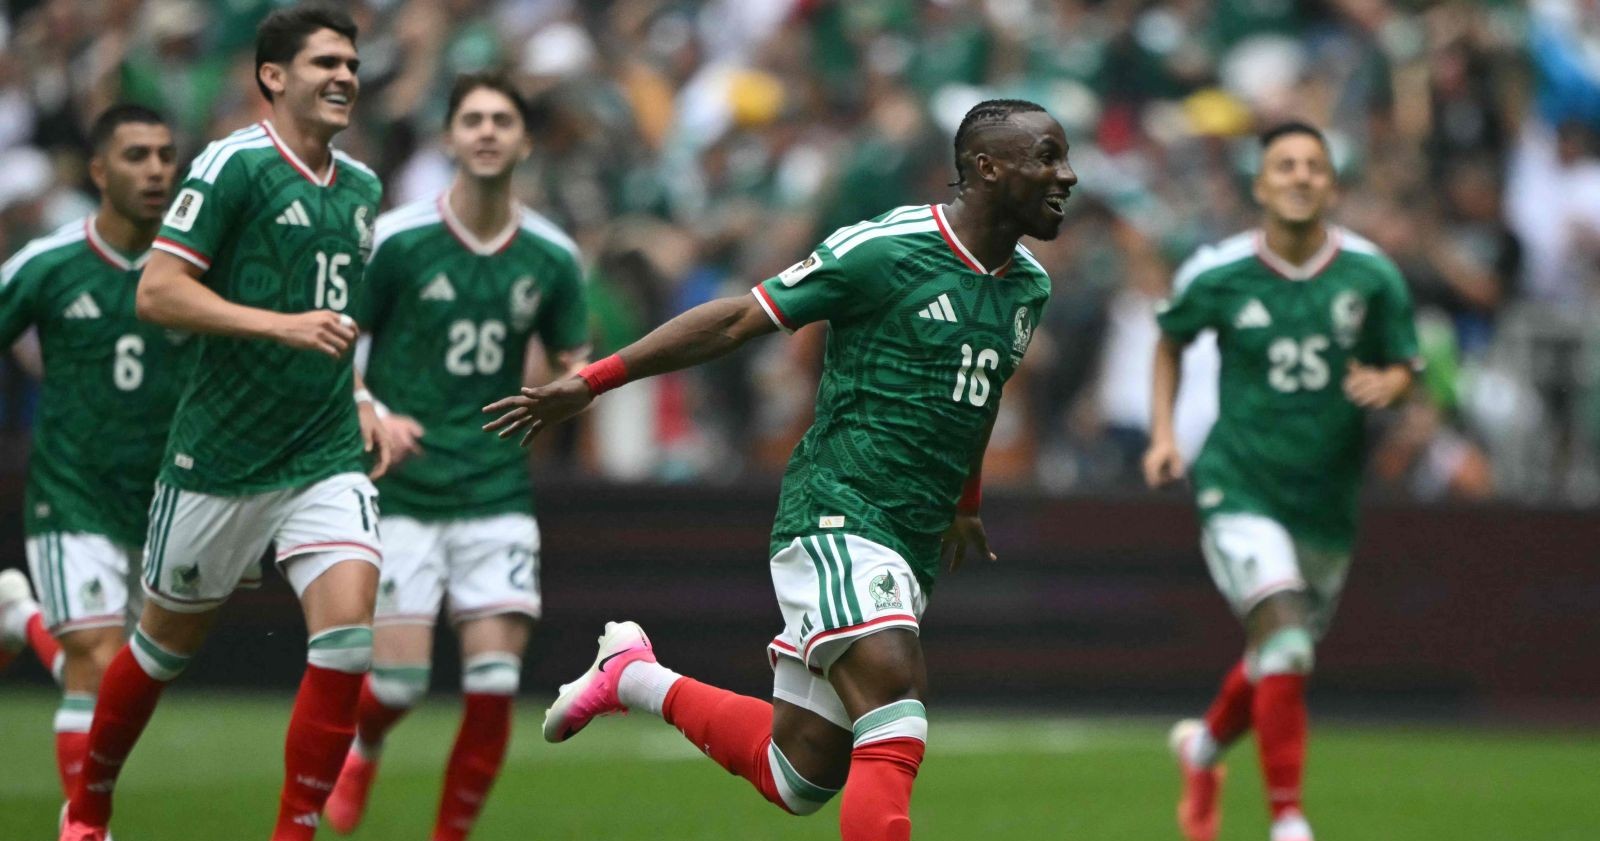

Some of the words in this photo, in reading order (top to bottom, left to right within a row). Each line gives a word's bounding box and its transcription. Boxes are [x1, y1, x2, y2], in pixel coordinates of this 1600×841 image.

[315, 251, 351, 311] 15
[114, 333, 145, 391] 6
[446, 319, 506, 375] 26
[953, 344, 999, 407] 16
[1268, 336, 1330, 393] 25
